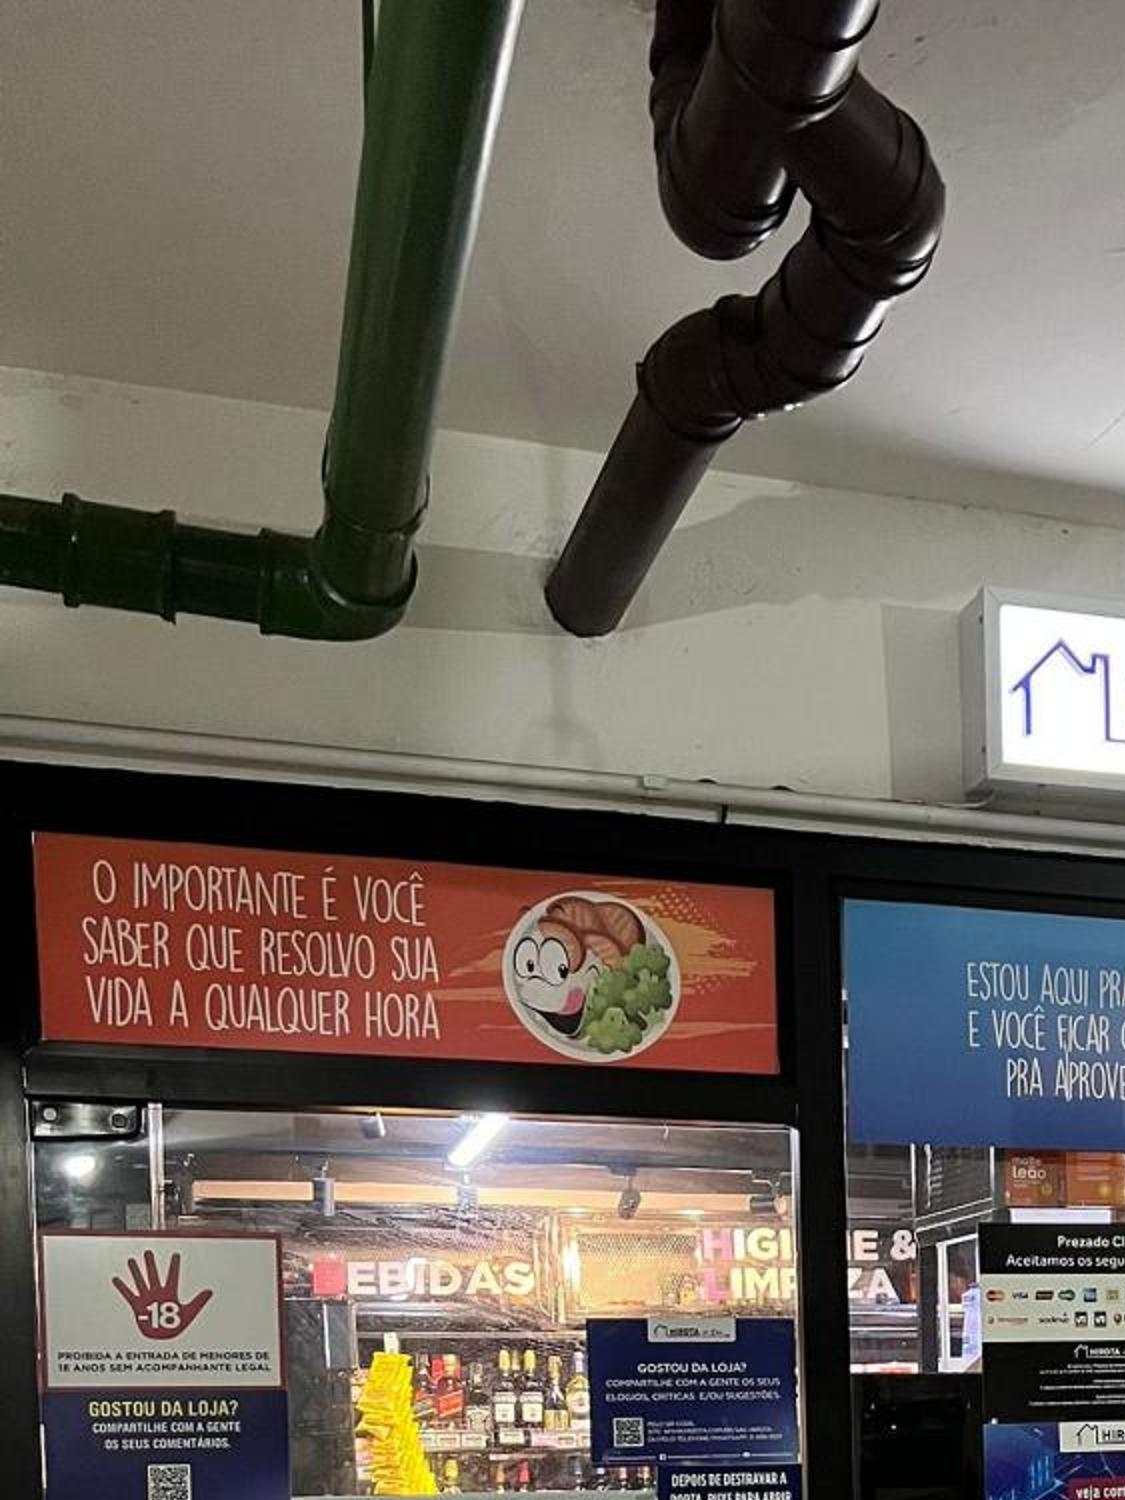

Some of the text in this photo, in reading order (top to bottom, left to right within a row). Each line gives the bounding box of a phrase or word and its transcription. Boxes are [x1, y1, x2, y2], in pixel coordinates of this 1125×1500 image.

[93, 861, 426, 926] O IMPORTANTE É VOCÊ
[83, 918, 440, 983] SABER QUE RESOLVO SUA
[966, 961, 1030, 1002] ESTOU
[1040, 965, 1089, 1008] AQUI
[85, 977, 441, 1041] VIDA A QUALQUER HORA
[968, 1015, 980, 1049] E
[990, 1005, 1046, 1051] VOCÊ
[1058, 1015, 1110, 1054] FICAR
[1007, 1060, 1043, 1098] PRA
[891, 1229, 916, 1261] &
[1057, 1235, 1110, 1248] Prezado
[1005, 1254, 1075, 1267] Aceitamos
[1077, 1257, 1093, 1266] os
[312, 1257, 536, 1296] BEBIDAS
[138, 1301, 182, 1329] -18
[57, 1351, 270, 1361] PROIBIDA A ENTRADA DE MENORES DE
[73, 1362, 271, 1373] ANOS SEM ACOMPANHANTE LEGAL
[637, 1362, 748, 1374] GOSTOU DA LOJA?
[675, 1378, 698, 1387] COM
[708, 1378, 739, 1387] GENTE
[756, 1377, 781, 1386] SEUS
[89, 1400, 238, 1417] GOSTOU DA LOJA?
[92, 1421, 241, 1434] COMPARTILHE COM A GENTE
[105, 1438, 149, 1449] OS SEUS
[672, 1472, 787, 1487] DEPOIS DE DESTRAVAR A
